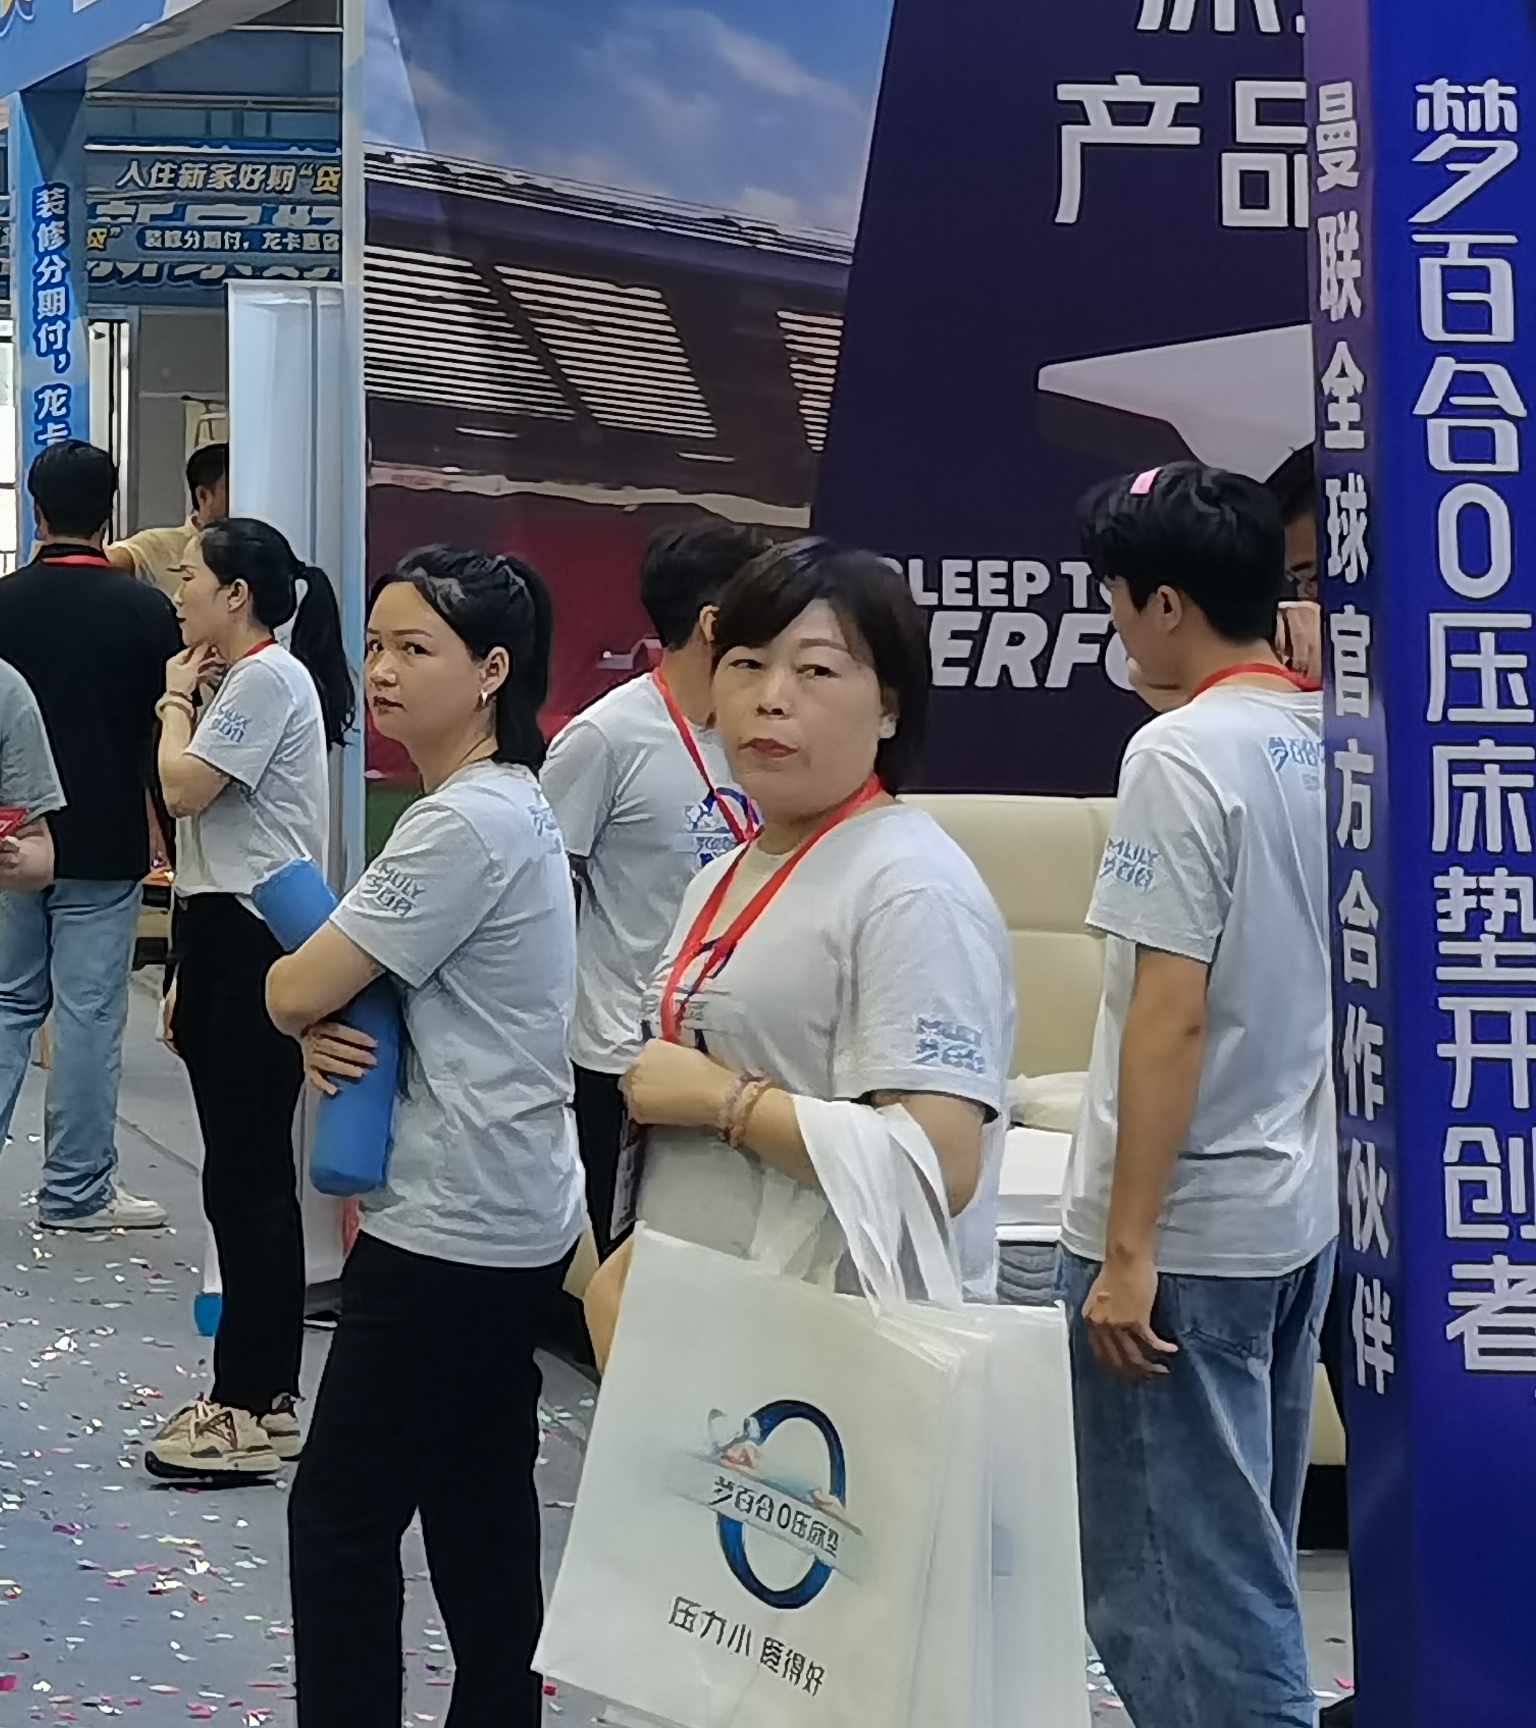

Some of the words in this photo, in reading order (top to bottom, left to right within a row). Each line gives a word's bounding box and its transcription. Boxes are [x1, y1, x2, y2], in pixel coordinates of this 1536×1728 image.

[1053, 73, 1310, 229] 产品
[879, 557, 1051, 608] LEEP
[930, 610, 1138, 690] ERF
[1315, 79, 1396, 1396] 曼联全球官方合作伙伴
